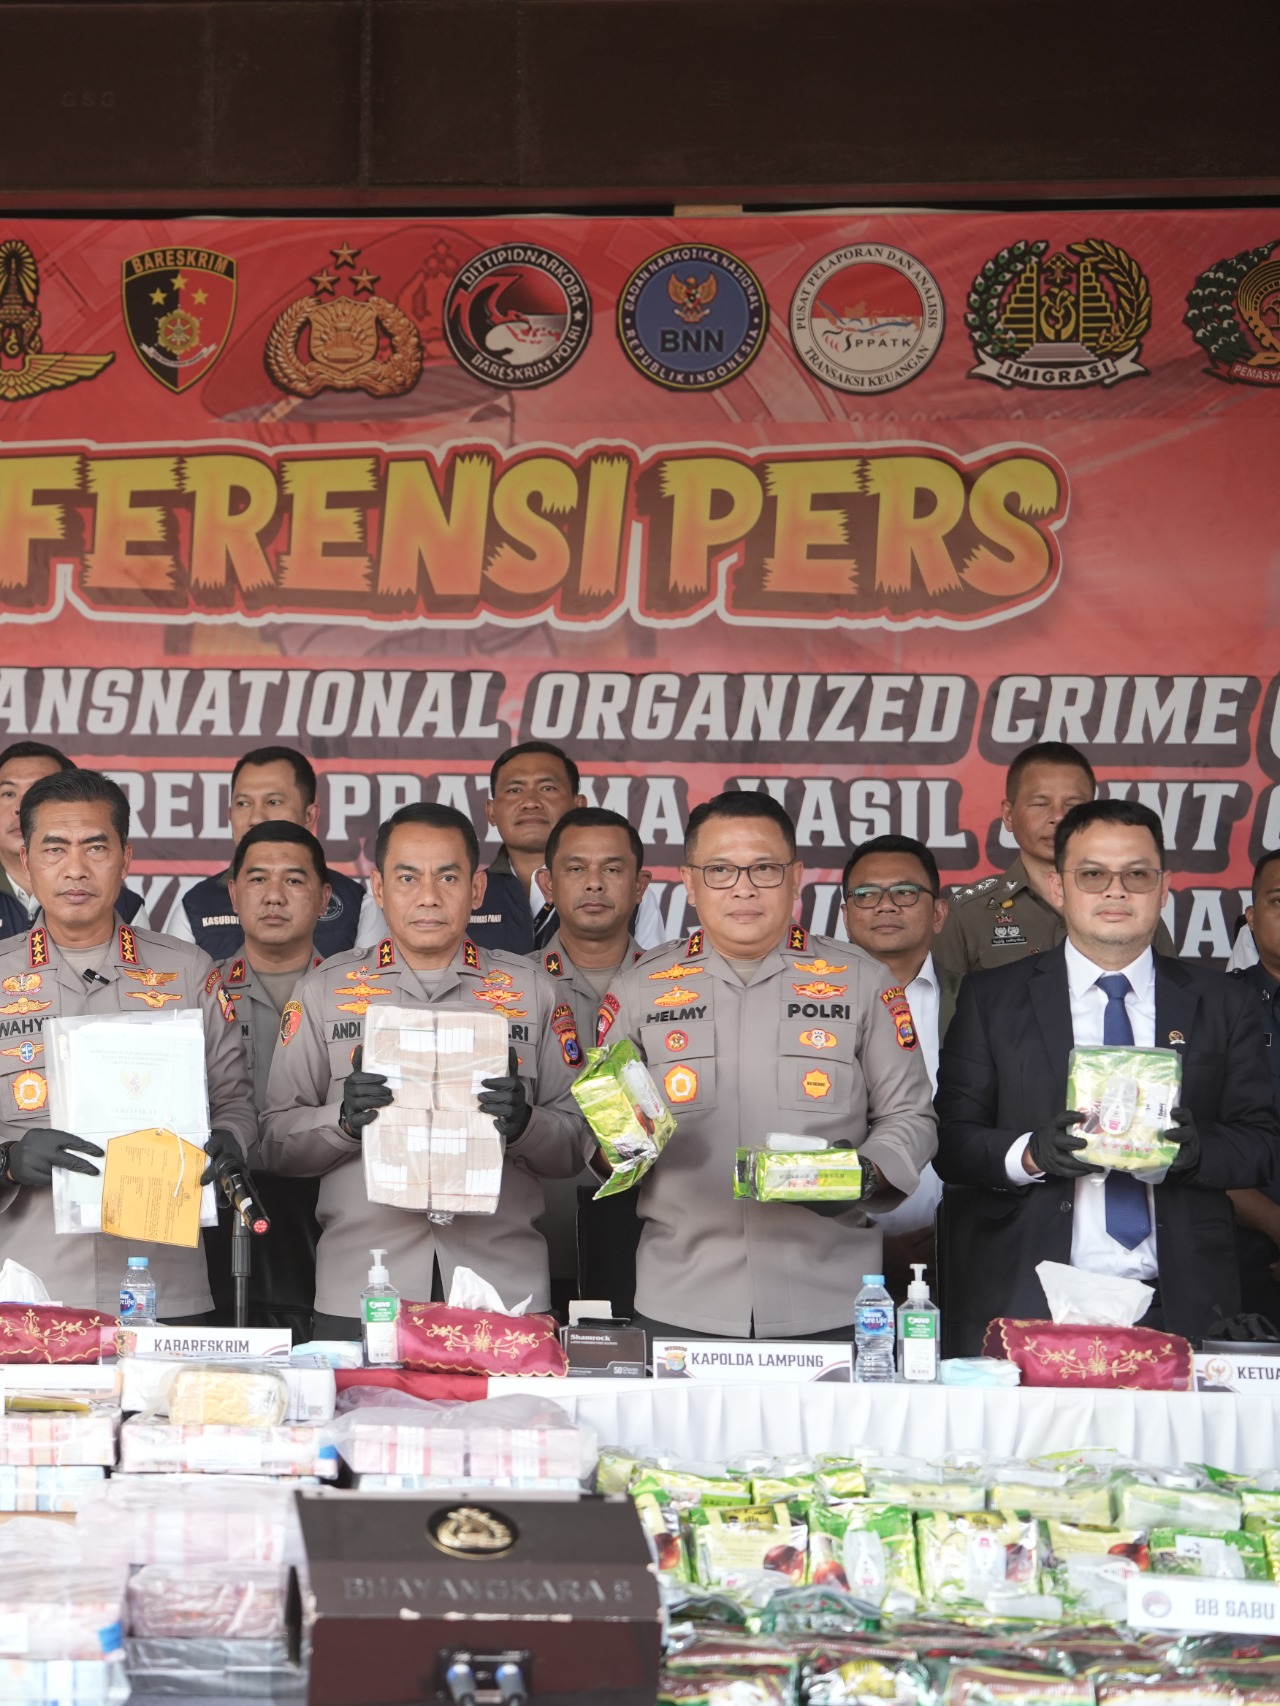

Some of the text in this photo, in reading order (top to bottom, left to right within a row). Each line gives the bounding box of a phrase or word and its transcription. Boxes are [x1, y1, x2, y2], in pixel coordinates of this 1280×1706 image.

[131, 250, 228, 274] BARESKRIM
[461, 249, 583, 306] DITTIPIDNARKOBA
[624, 249, 759, 311] BADAN NARKOTIKA NASIONAL
[797, 247, 938, 330] PUSAT PELAPORAN DAN ANALISIS
[471, 325, 582, 380] BARESKRIM POLRI
[660, 330, 724, 353] BNN
[855, 338, 911, 347] PPATK
[625, 329, 758, 383] REPUBLIK INDONESIA
[805, 344, 930, 387] TRANSAKSI KEUANGAN
[1004, 361, 1114, 385] IMIGRASI
[658, 455, 1060, 597] PERS
[530, 671, 963, 744] ORGANIZED
[991, 675, 1248, 745] CRIME
[202, 915, 240, 927] KASUBDI
[646, 1005, 707, 1023] HELMY
[787, 1003, 851, 1020] POLRI
[331, 1021, 361, 1040] ANDI
[154, 1338, 250, 1354] KABARESKRIM
[614, 1366, 623, 1374] 50
[691, 1350, 824, 1369] KAPOLDA LAMPUNG
[343, 1577, 606, 1601] BHAYANGKARA
[1194, 1597, 1275, 1620] BB SABU
